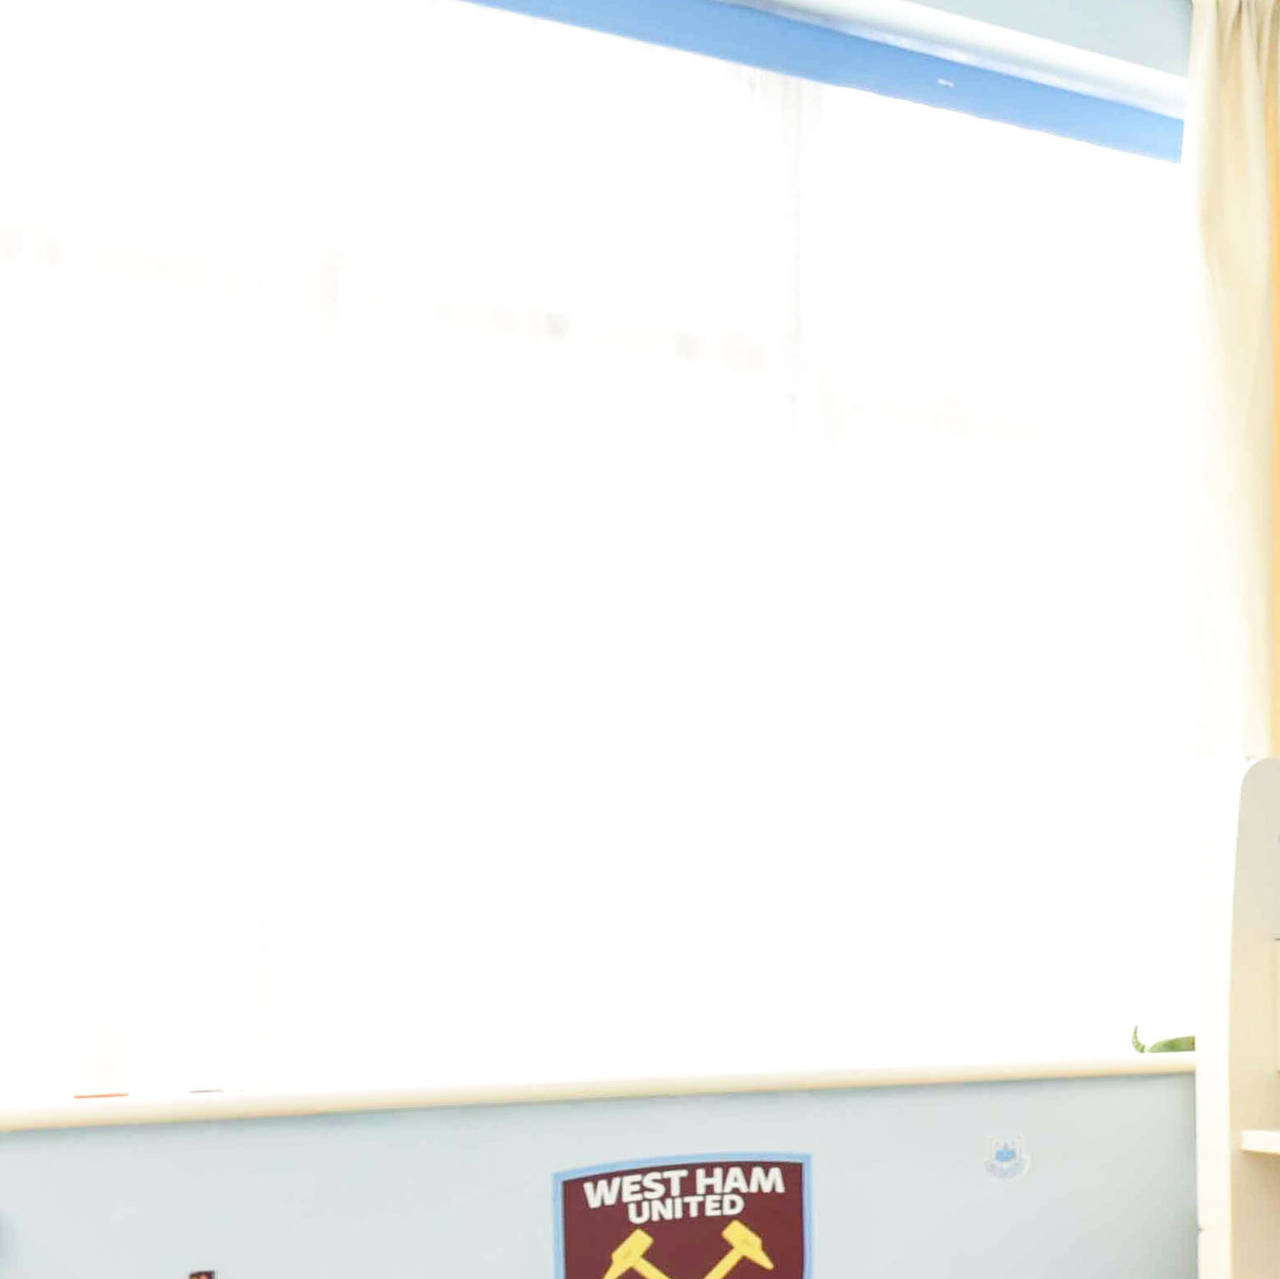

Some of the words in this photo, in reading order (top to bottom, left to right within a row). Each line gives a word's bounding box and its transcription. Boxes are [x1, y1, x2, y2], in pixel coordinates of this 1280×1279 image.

[583, 1169, 688, 1208] WEST
[695, 1166, 785, 1194] HAM
[627, 1194, 745, 1224] UNITED
